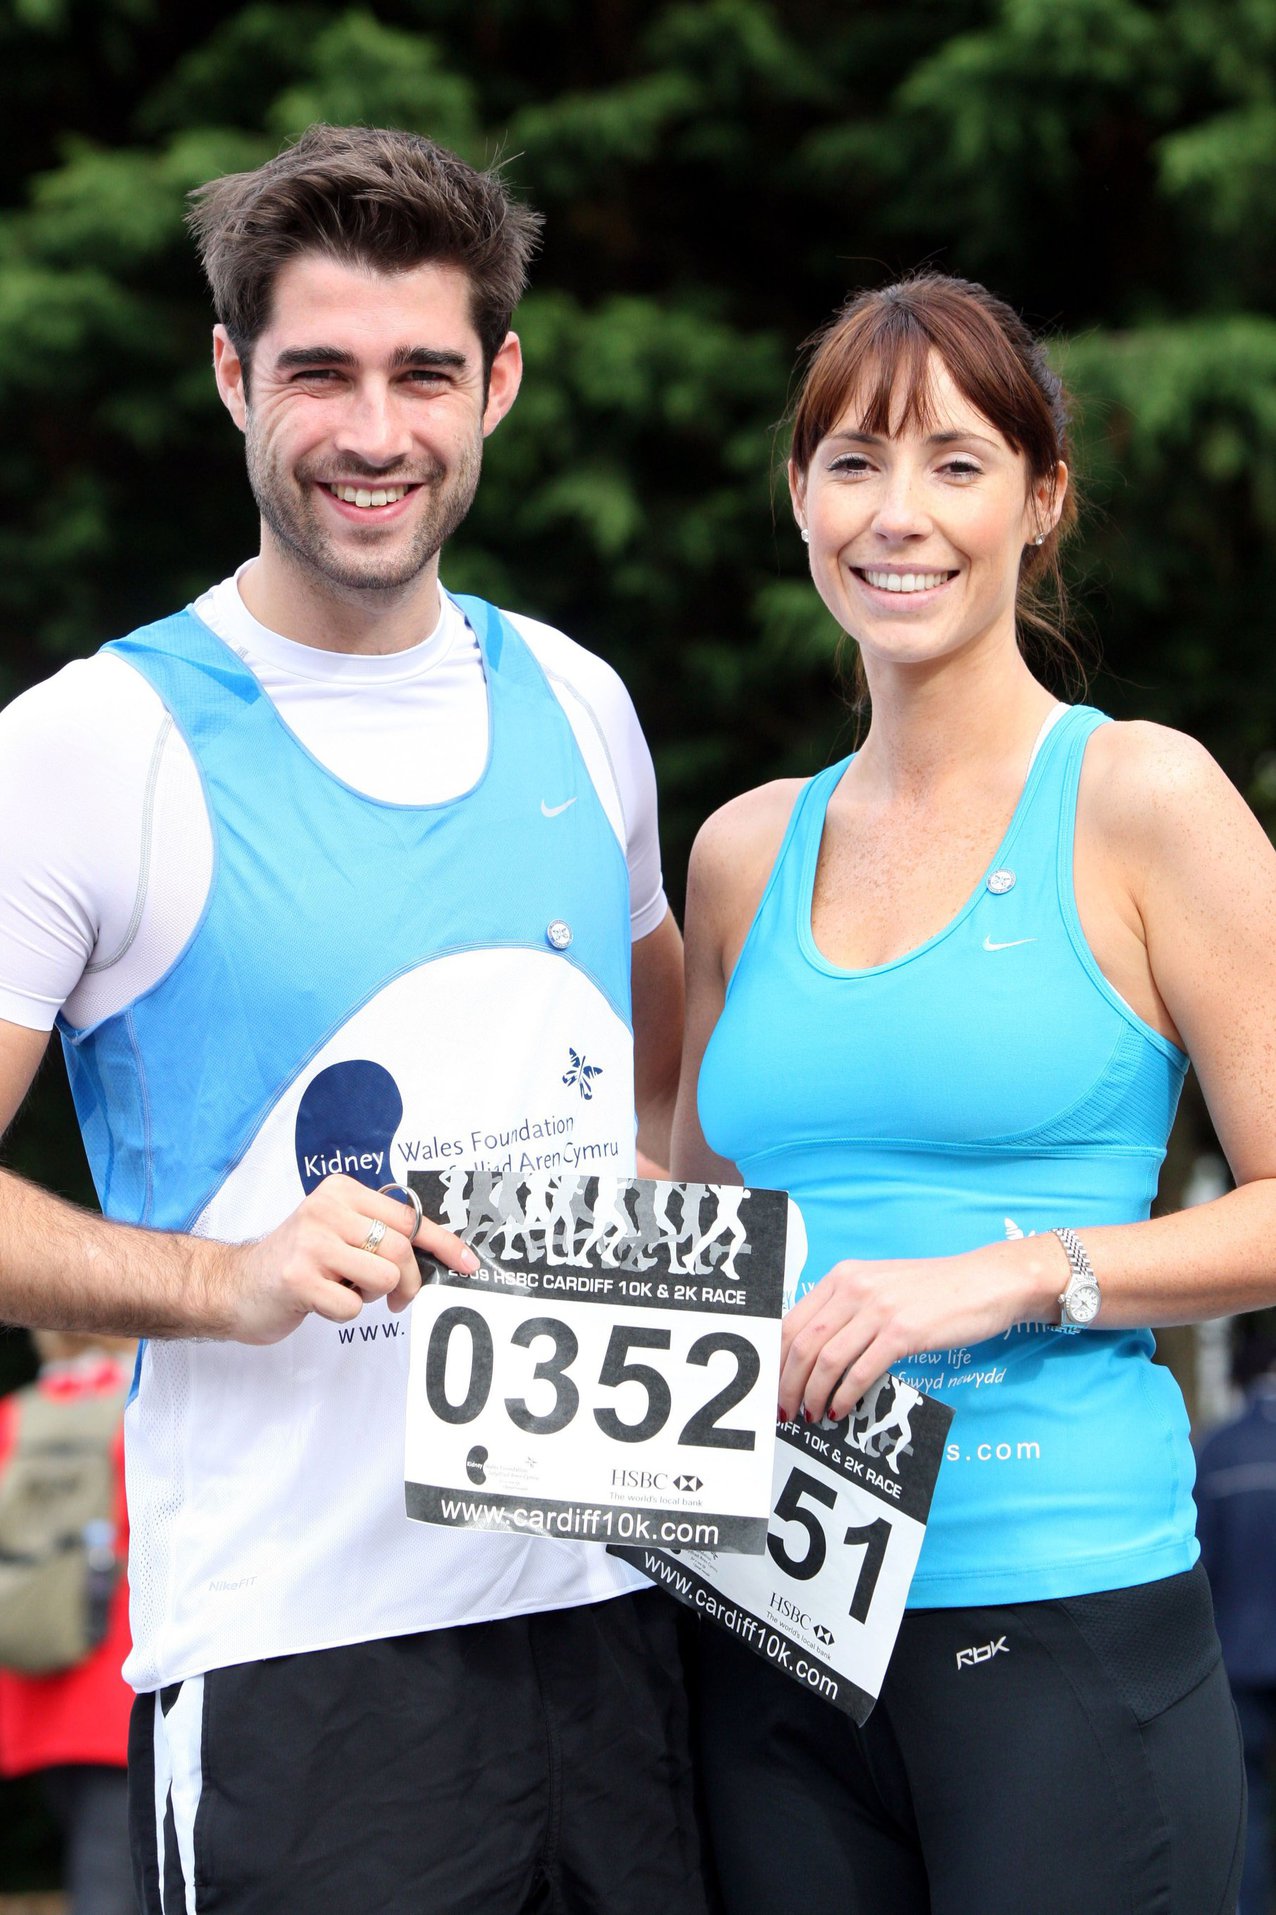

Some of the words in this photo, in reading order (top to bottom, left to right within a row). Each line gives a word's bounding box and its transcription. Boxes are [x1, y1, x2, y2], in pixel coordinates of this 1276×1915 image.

[304, 1150, 384, 1178] Kidney
[398, 1136, 464, 1162] Wales
[471, 1116, 574, 1151] Foundation
[520, 1152, 561, 1173] Aren
[563, 1141, 619, 1168] Cymru
[494, 1270, 539, 1288] HSBC
[543, 1275, 613, 1294] CARDIFF
[618, 1280, 652, 1298] 10K
[657, 1283, 669, 1298] &
[674, 1285, 698, 1301] 2K
[701, 1288, 746, 1305] RACE
[425, 1306, 760, 1451] 0352
[948, 1348, 972, 1369] life
[948, 1367, 1007, 1388] newydd
[611, 1469, 668, 1490] HSBC
[804, 1431, 830, 1456] 10K
[831, 1449, 841, 1464] &
[844, 1456, 864, 1476] 2K
[866, 1468, 902, 1499] RACE
[610, 1491, 625, 1500] The
[660, 1496, 680, 1505] local
[682, 1498, 703, 1506] bank
[441, 1499, 719, 1545] www.cardiff10k.com
[767, 1466, 893, 1625] 51
[644, 1551, 839, 1700] www.cardiff10k.com
[769, 1592, 812, 1630] HSBC
[766, 1611, 778, 1623] The
[801, 1635, 815, 1649] local
[817, 1646, 831, 1661] bank
